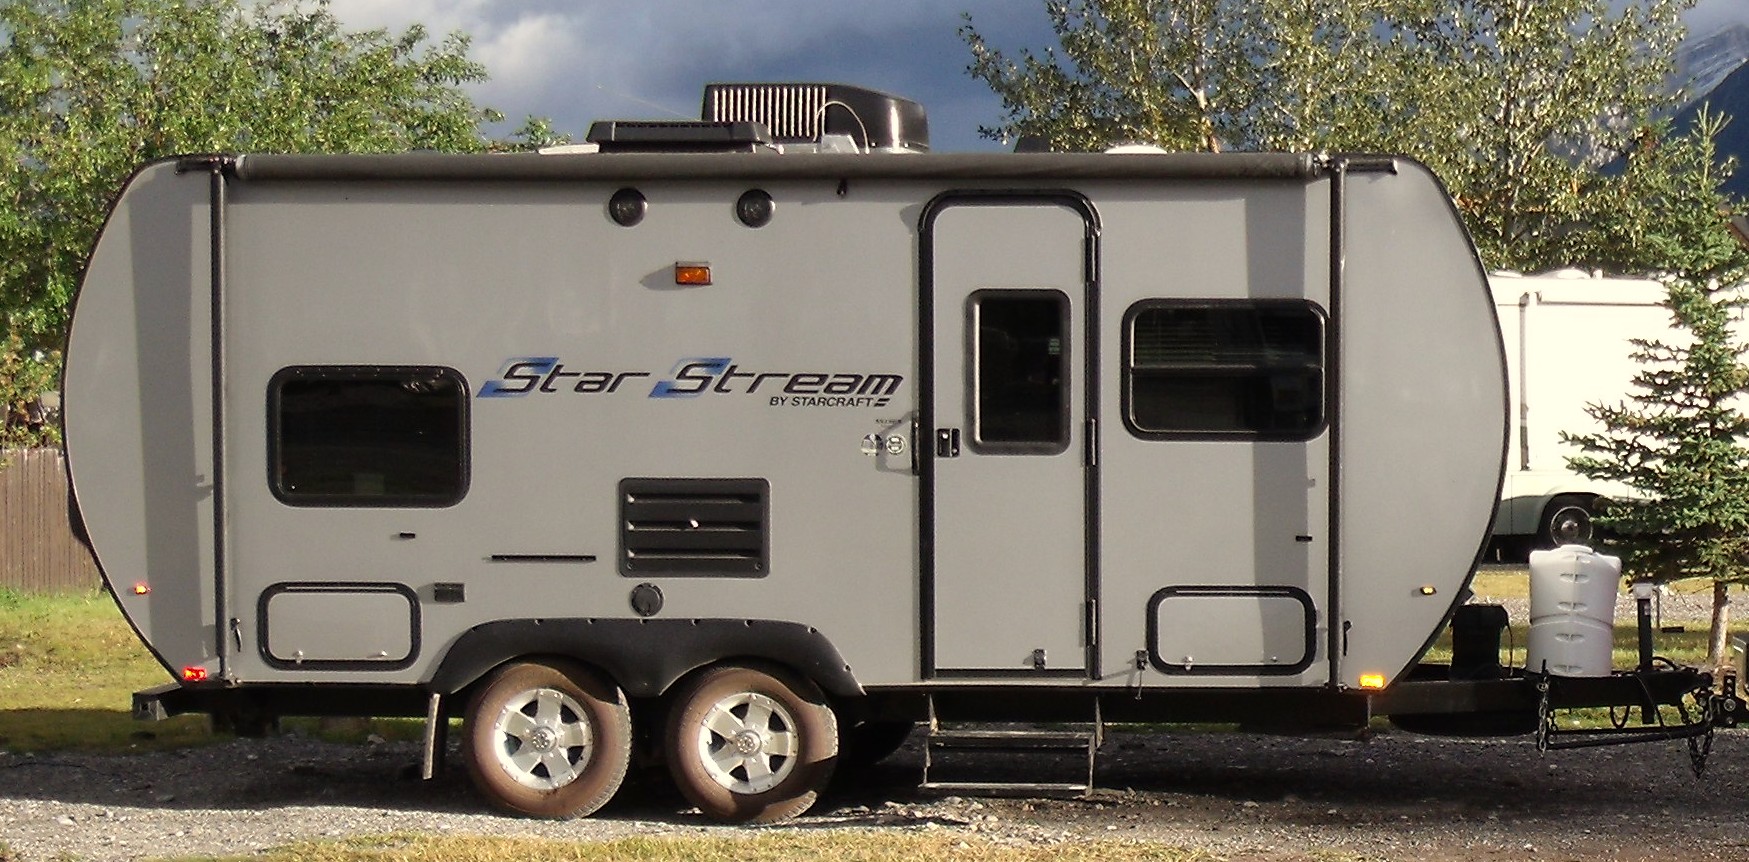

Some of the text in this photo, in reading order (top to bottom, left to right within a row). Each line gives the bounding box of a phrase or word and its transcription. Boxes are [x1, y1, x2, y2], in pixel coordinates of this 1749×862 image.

[484, 359, 903, 396] Star Stream
[769, 397, 873, 407] BY STARCRAFT
